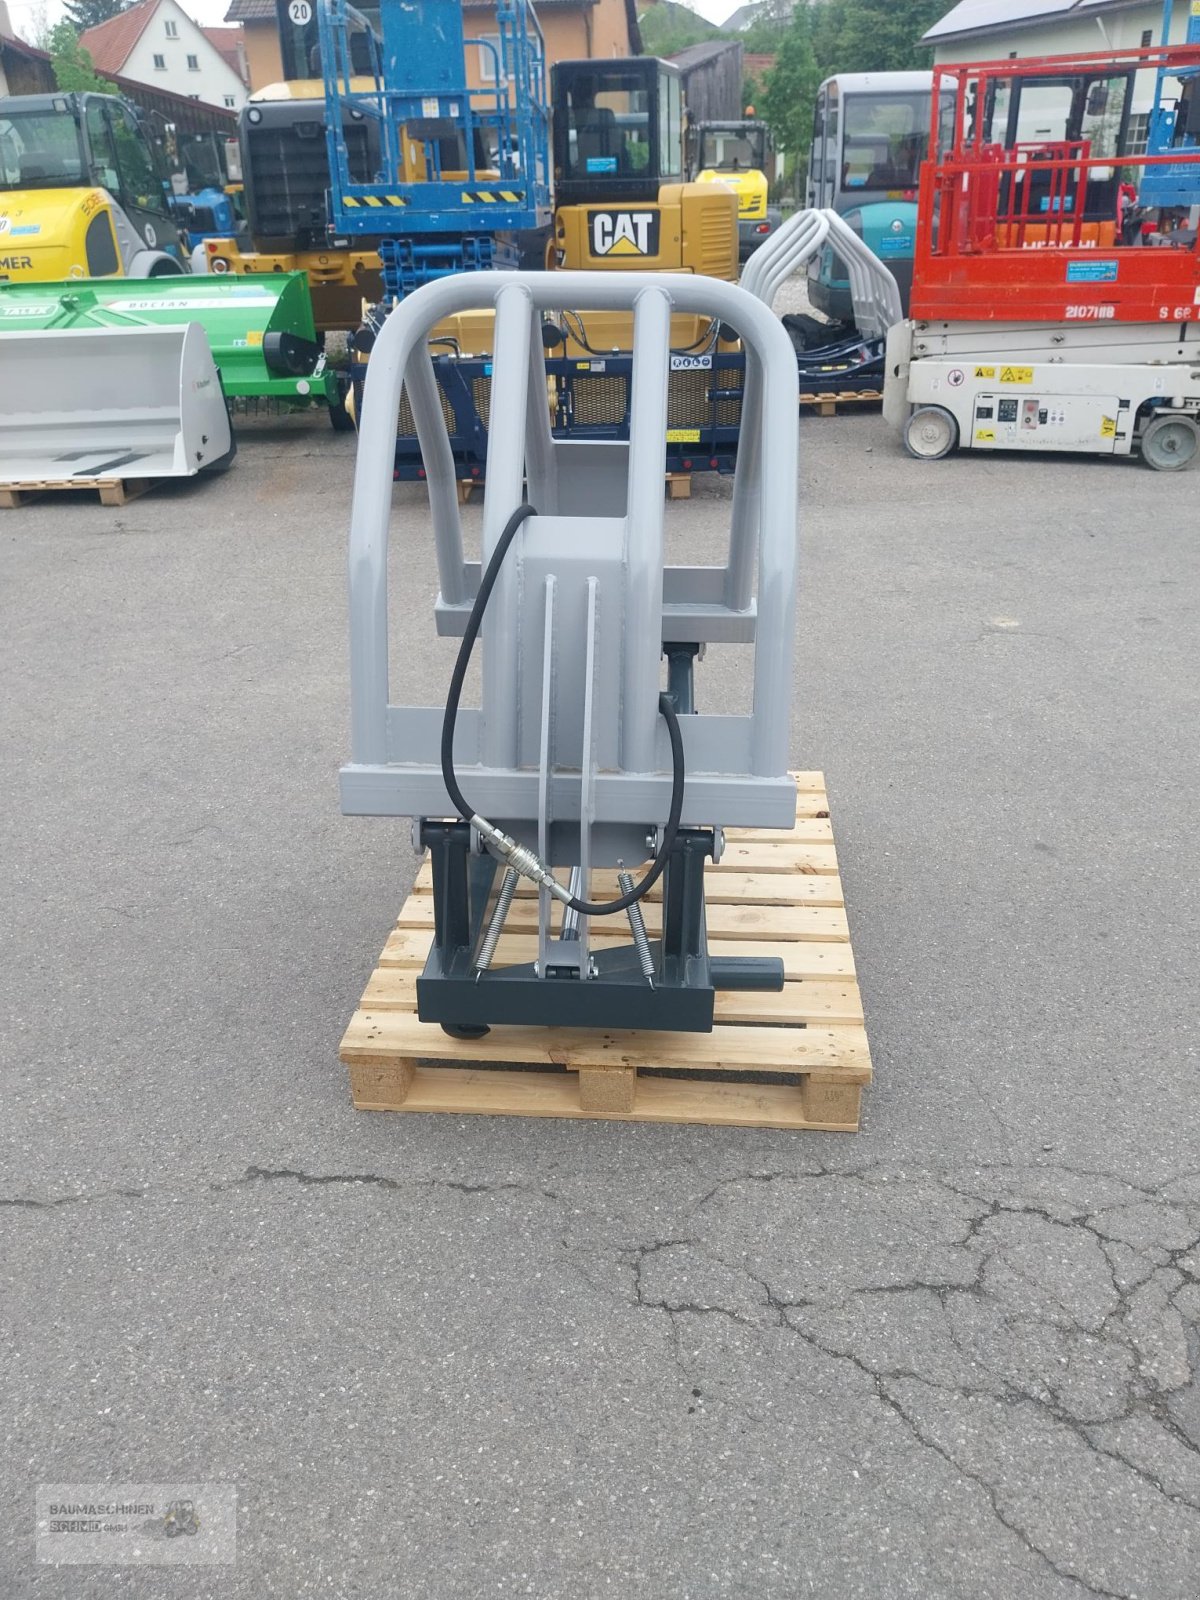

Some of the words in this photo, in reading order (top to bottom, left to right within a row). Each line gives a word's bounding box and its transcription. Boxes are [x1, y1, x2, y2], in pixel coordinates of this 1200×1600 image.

[293, 4, 307, 19] 20
[594, 213, 653, 255] CAT
[1159, 306, 1169, 319] S
